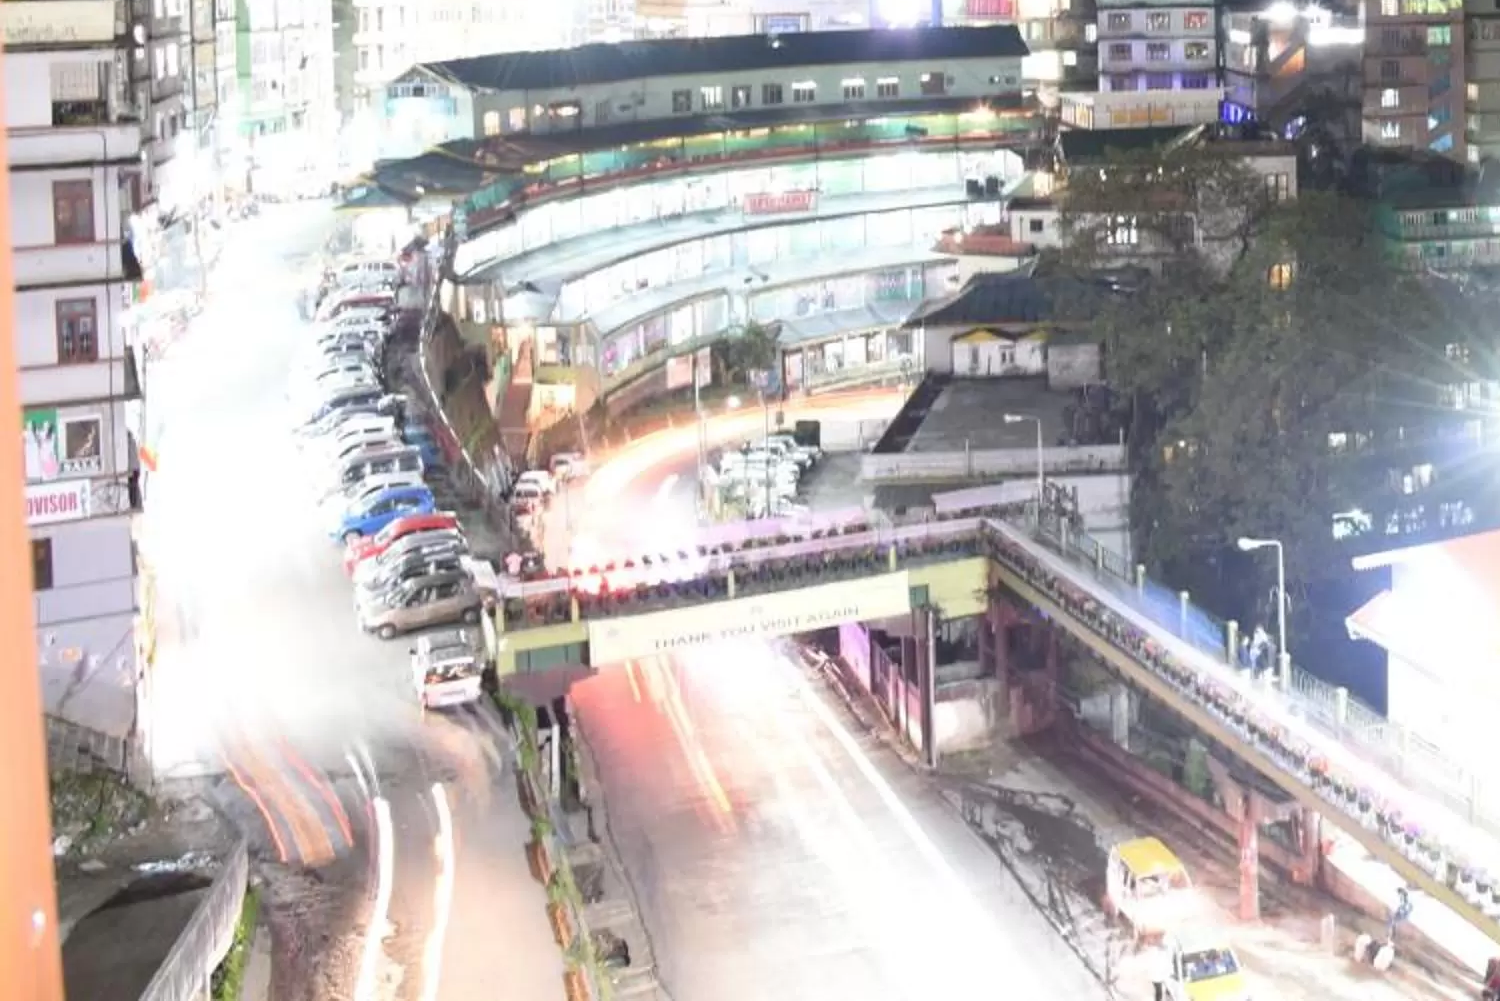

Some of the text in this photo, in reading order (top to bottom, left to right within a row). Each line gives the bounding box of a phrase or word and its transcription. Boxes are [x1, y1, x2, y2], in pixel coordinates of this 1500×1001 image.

[653, 603, 860, 650] THANK YOU VISIT AGAIN
